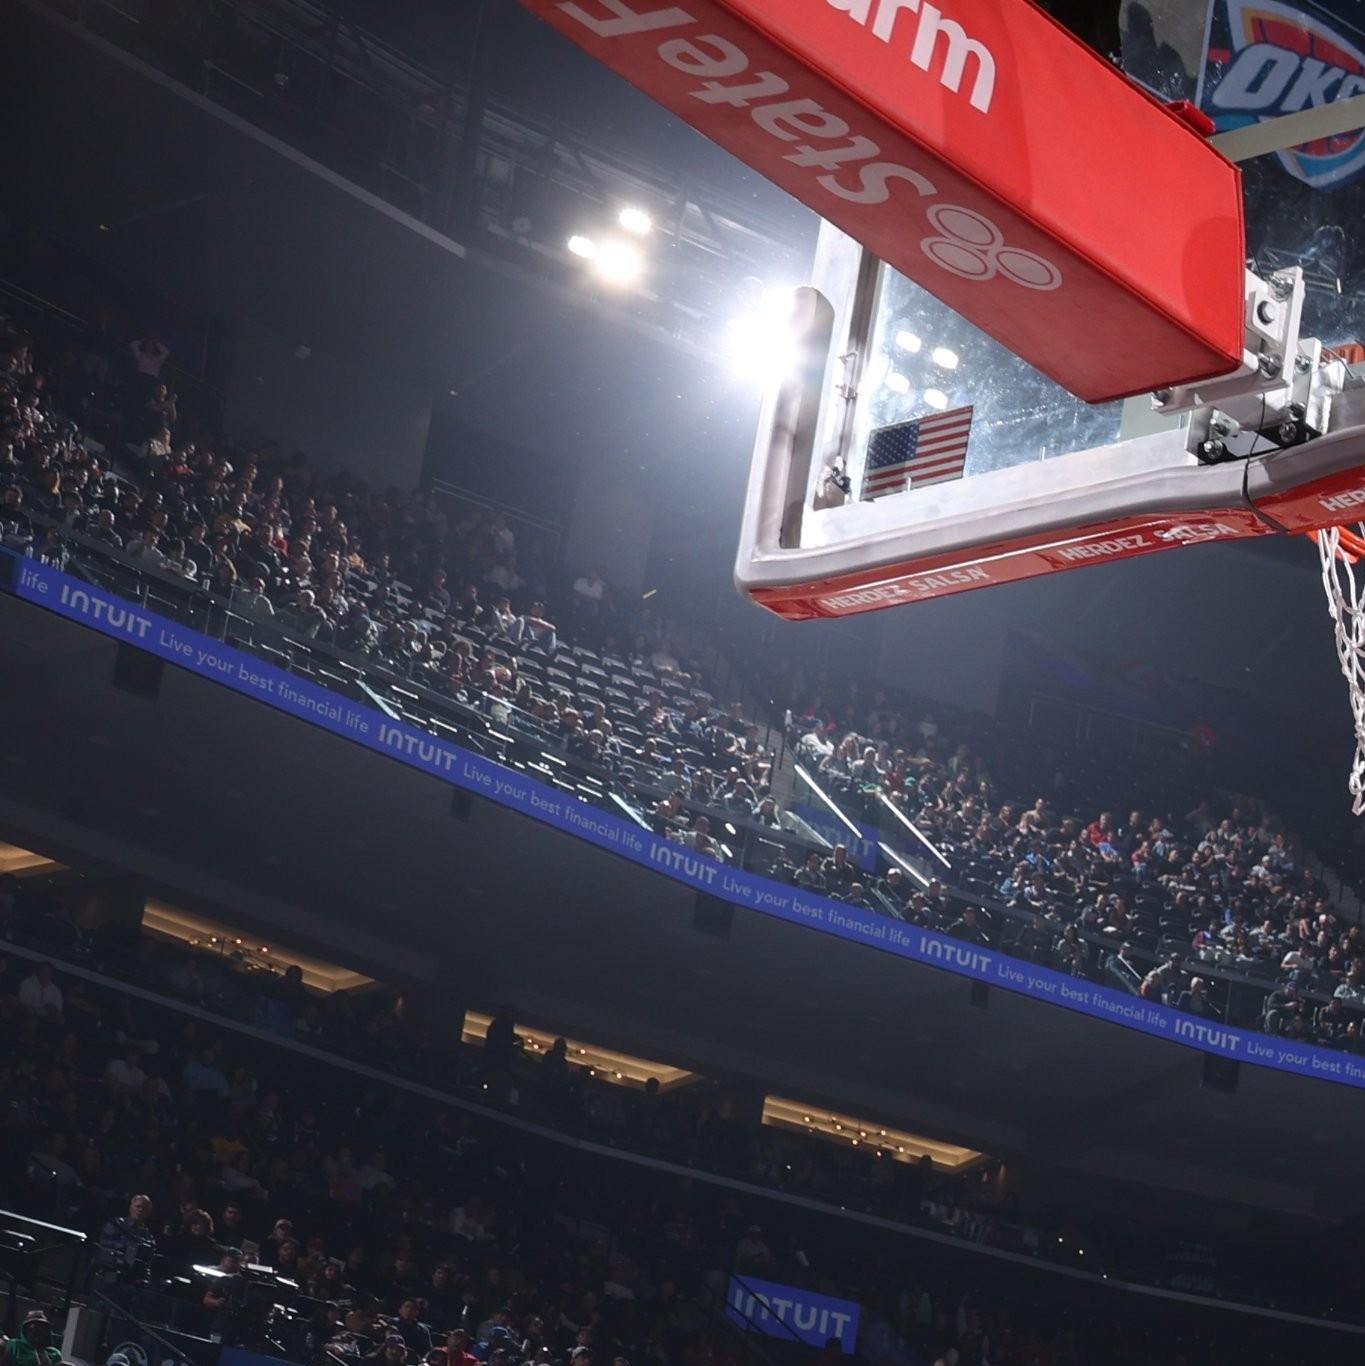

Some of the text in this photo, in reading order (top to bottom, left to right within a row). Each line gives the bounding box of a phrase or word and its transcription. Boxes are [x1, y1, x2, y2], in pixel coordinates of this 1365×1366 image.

[1057, 534, 1150, 562] HERDEZ
[822, 565, 985, 613] HERDEZ SALSA
[20, 567, 49, 595] life
[60, 584, 152, 640] INTUIT
[159, 629, 194, 657] Live
[197, 648, 235, 677] your
[237, 661, 275, 690] best
[277, 681, 342, 722] financial
[345, 707, 371, 734] life
[379, 724, 457, 772] INTUIT
[463, 760, 492, 787] Live
[495, 777, 528, 804] your
[530, 788, 561, 816] best
[564, 803, 620, 841] financial
[621, 826, 643, 852] life
[650, 843, 718, 885] INTUIT
[722, 875, 752, 899] Live
[756, 888, 789, 910] your
[791, 896, 824, 921] best
[827, 908, 886, 940] financial
[888, 924, 911, 947] life
[919, 937, 992, 973] INTUIT
[998, 963, 1025, 984] Live
[1027, 974, 1057, 996] your
[1060, 981, 1089, 1004] best
[1092, 993, 1145, 1022] financial
[1146, 1008, 1167, 1028] life
[1174, 1017, 1241, 1052] INTUIT
[1246, 1040, 1275, 1059] Live
[1277, 1050, 1308, 1070] your
[1311, 1054, 1342, 1074] best
[733, 1287, 852, 1340] INTUIT
